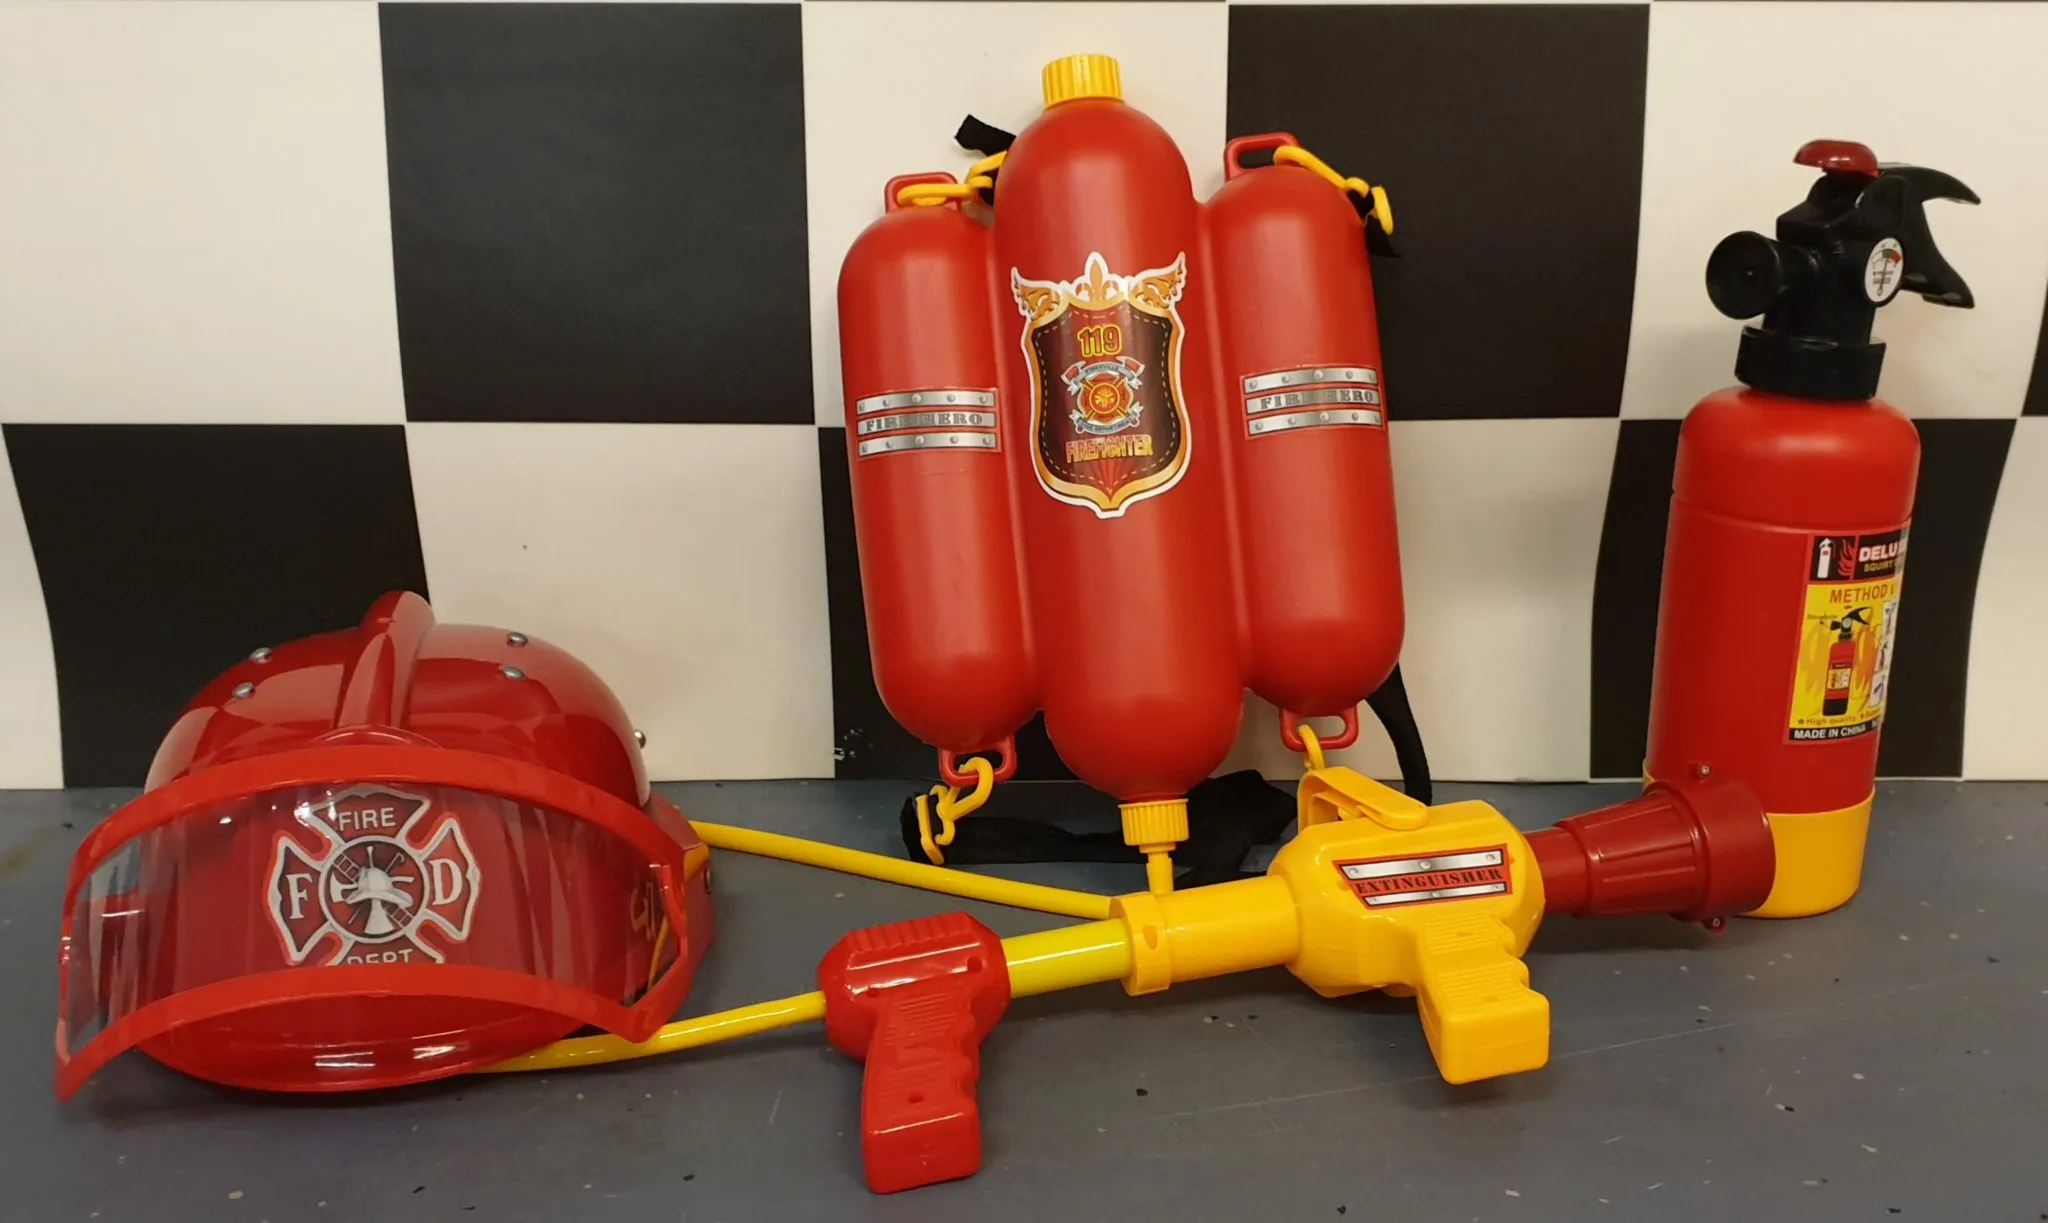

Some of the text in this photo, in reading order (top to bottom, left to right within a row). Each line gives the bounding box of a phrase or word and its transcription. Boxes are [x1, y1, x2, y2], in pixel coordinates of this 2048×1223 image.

[1078, 325, 1121, 356] 119
[1324, 389, 1373, 402] HERO
[920, 413, 983, 426] HERO
[1066, 434, 1153, 463] FIREFIGHTER
[1829, 584, 1888, 604] METHOD
[1794, 729, 1826, 739] MADE
[1828, 728, 1839, 738] IN
[1840, 724, 1866, 736] CHINA
[338, 807, 396, 831] FIRE
[429, 858, 463, 906] D
[1355, 868, 1504, 894] EXTINGUISHER
[285, 873, 312, 919] F
